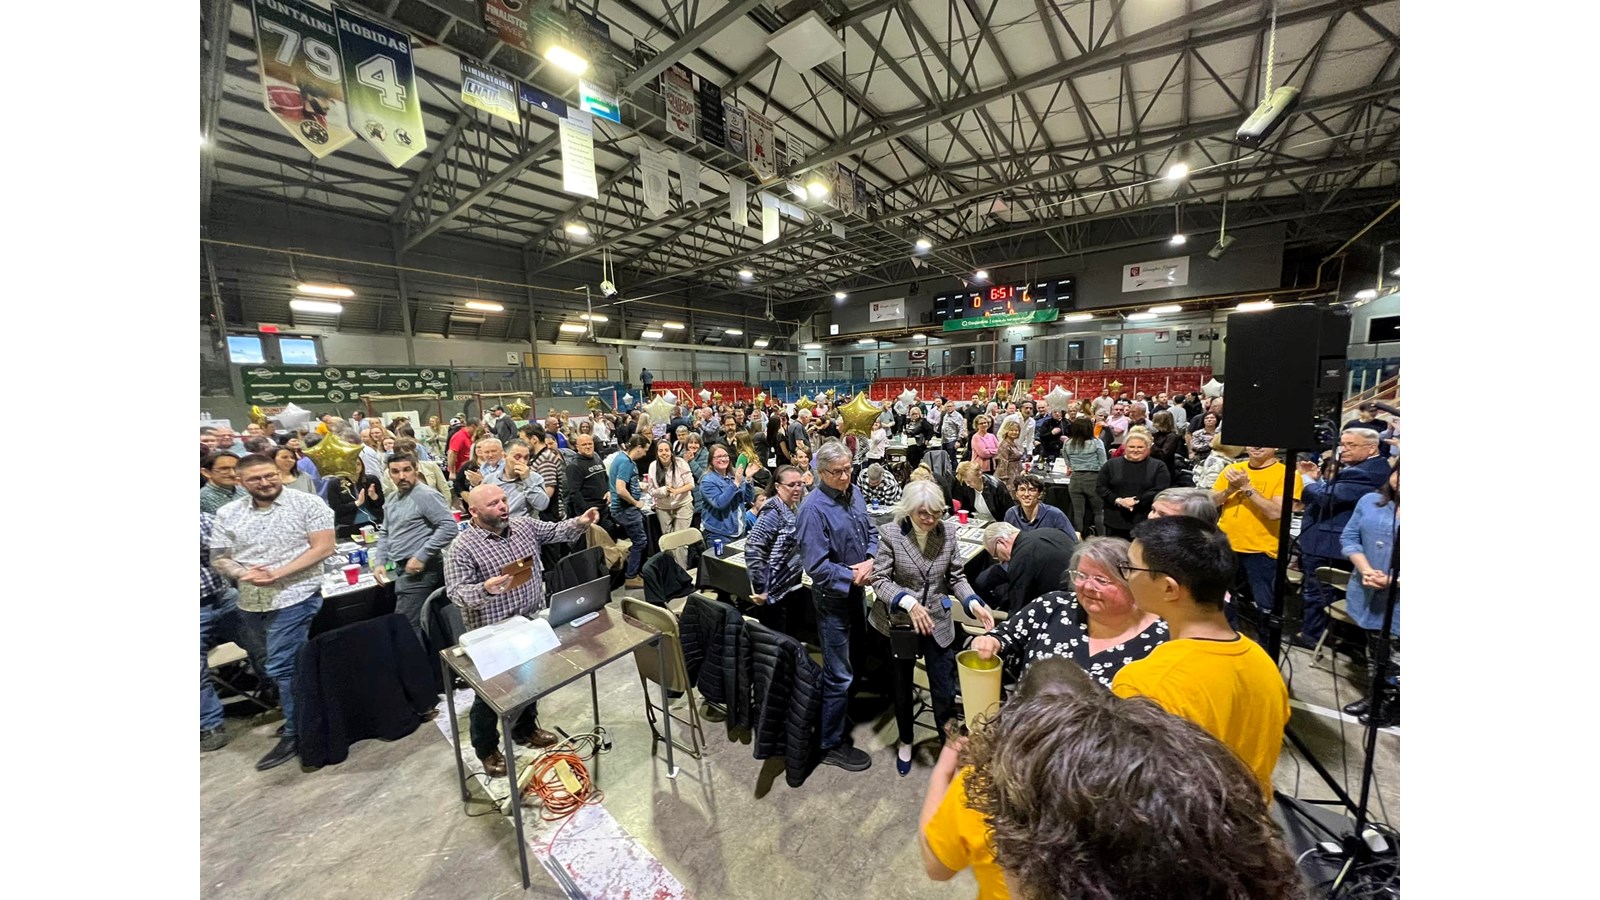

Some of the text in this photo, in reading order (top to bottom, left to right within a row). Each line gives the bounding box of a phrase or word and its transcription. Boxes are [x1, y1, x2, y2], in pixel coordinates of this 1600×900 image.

[259, 15, 341, 85] 79
[339, 18, 409, 54] ROBIDAS
[355, 53, 407, 112] 4
[973, 296, 981, 308] 0
[990, 286, 1013, 300] 6:51
